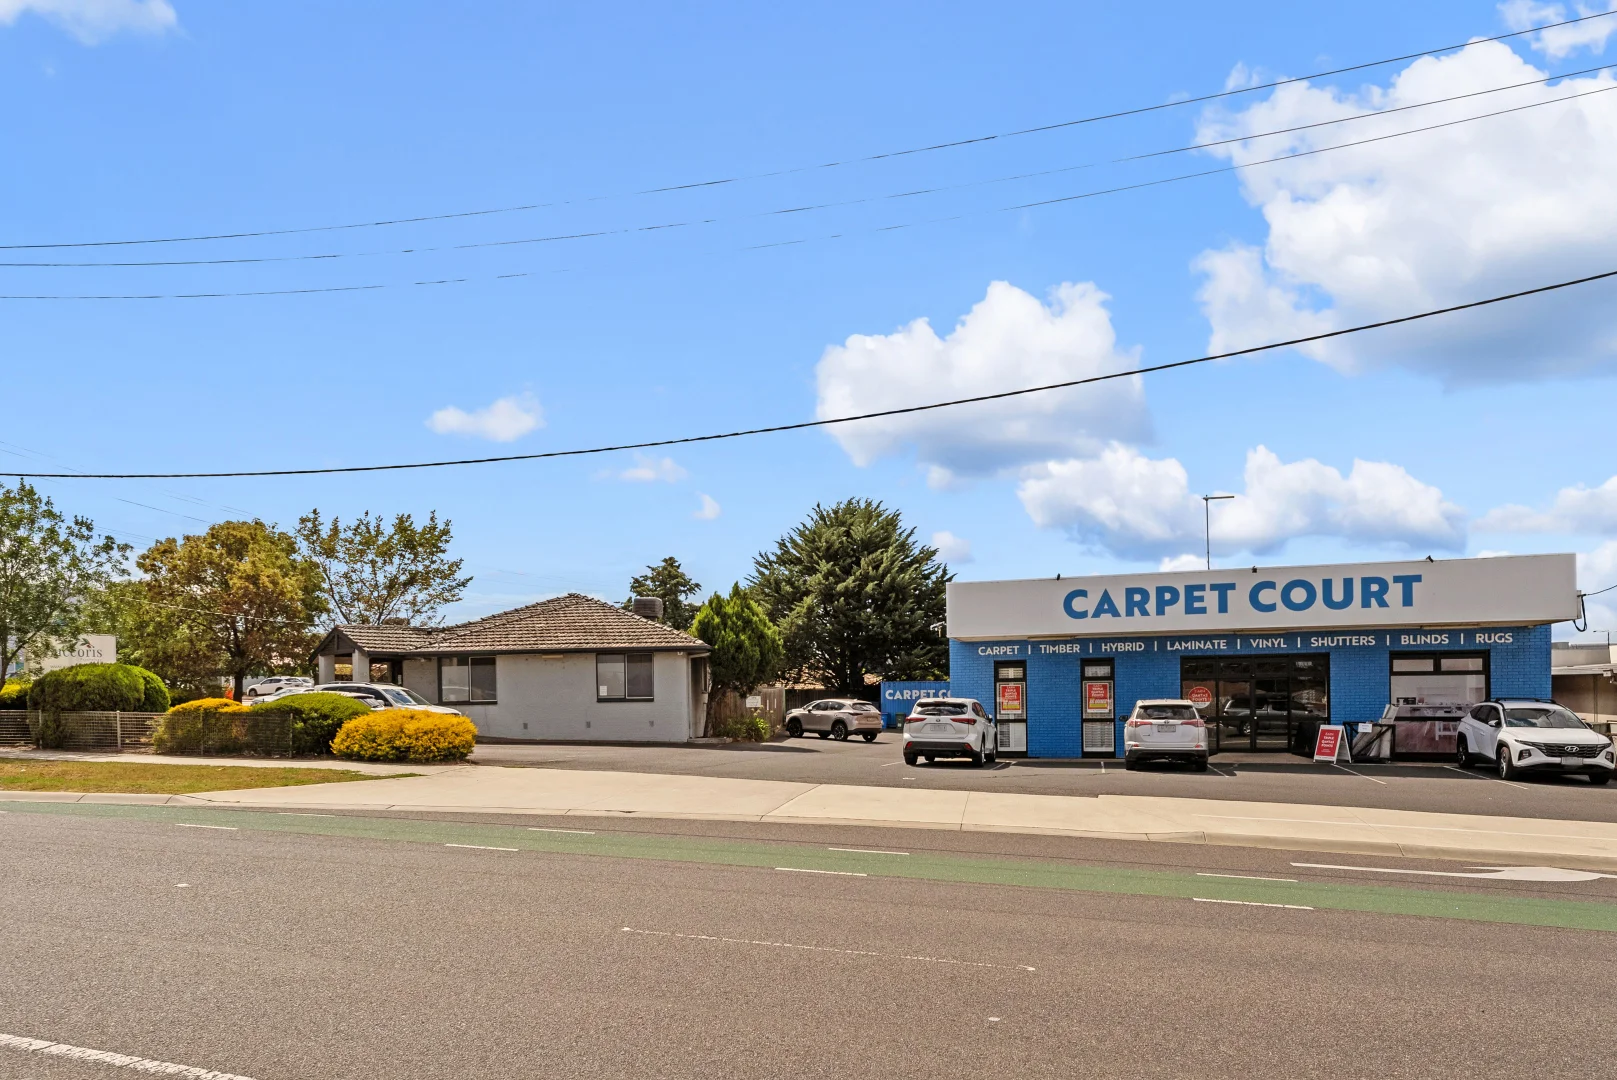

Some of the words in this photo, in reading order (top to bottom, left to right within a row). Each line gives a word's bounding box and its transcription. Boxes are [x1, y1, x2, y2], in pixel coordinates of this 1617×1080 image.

[1063, 583, 1236, 619] CARPET
[1249, 574, 1422, 613] COURT
[978, 646, 1019, 656] CARPET
[1039, 643, 1080, 654] TIMBER
[1101, 642, 1145, 652] HYBRID
[1167, 640, 1227, 650] LAMINATE
[1250, 638, 1287, 648] VINYL
[1310, 636, 1375, 647] SHUTTERS
[1401, 634, 1449, 645] BLINDS
[1475, 633, 1513, 644] RUGS
[885, 690, 935, 699] CARPET
